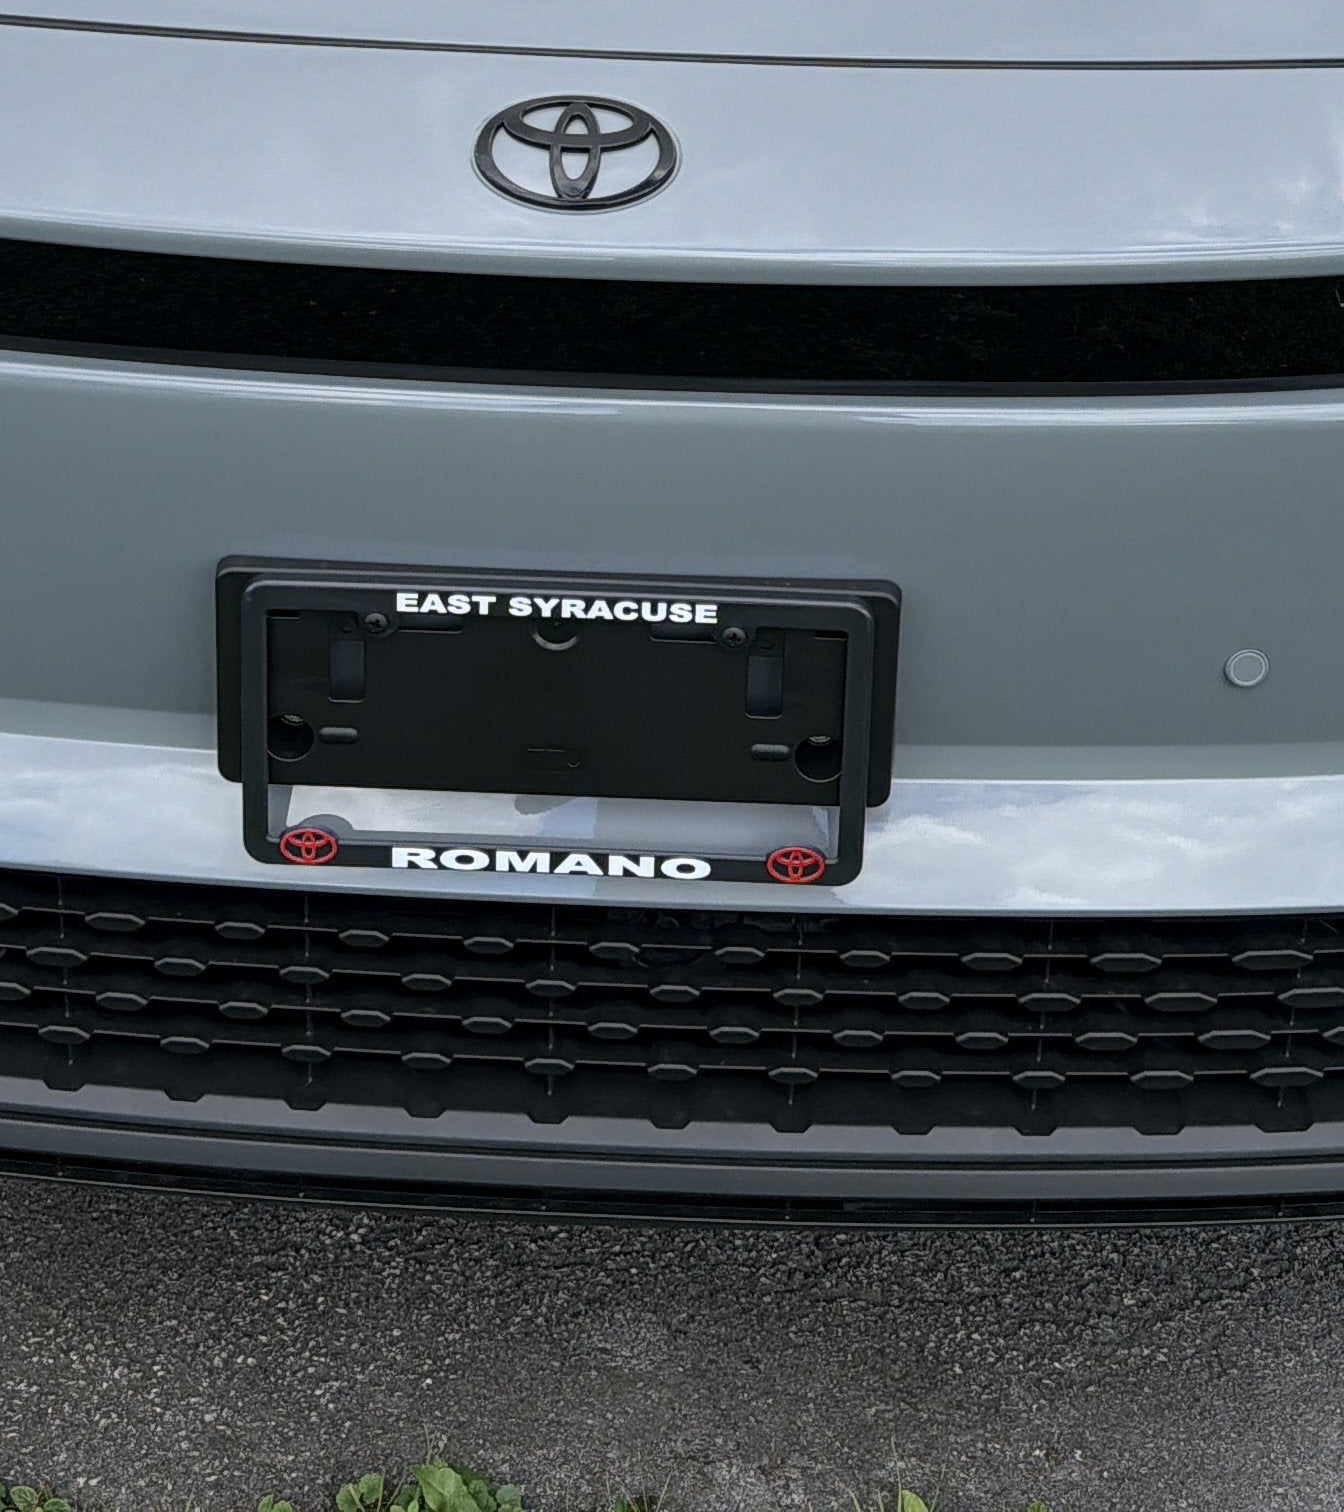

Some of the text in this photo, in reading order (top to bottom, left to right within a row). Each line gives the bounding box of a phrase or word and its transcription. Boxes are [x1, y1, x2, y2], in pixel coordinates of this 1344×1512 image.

[395, 592, 719, 625] EAST SYRACUSE
[391, 846, 712, 880] ROMANO
